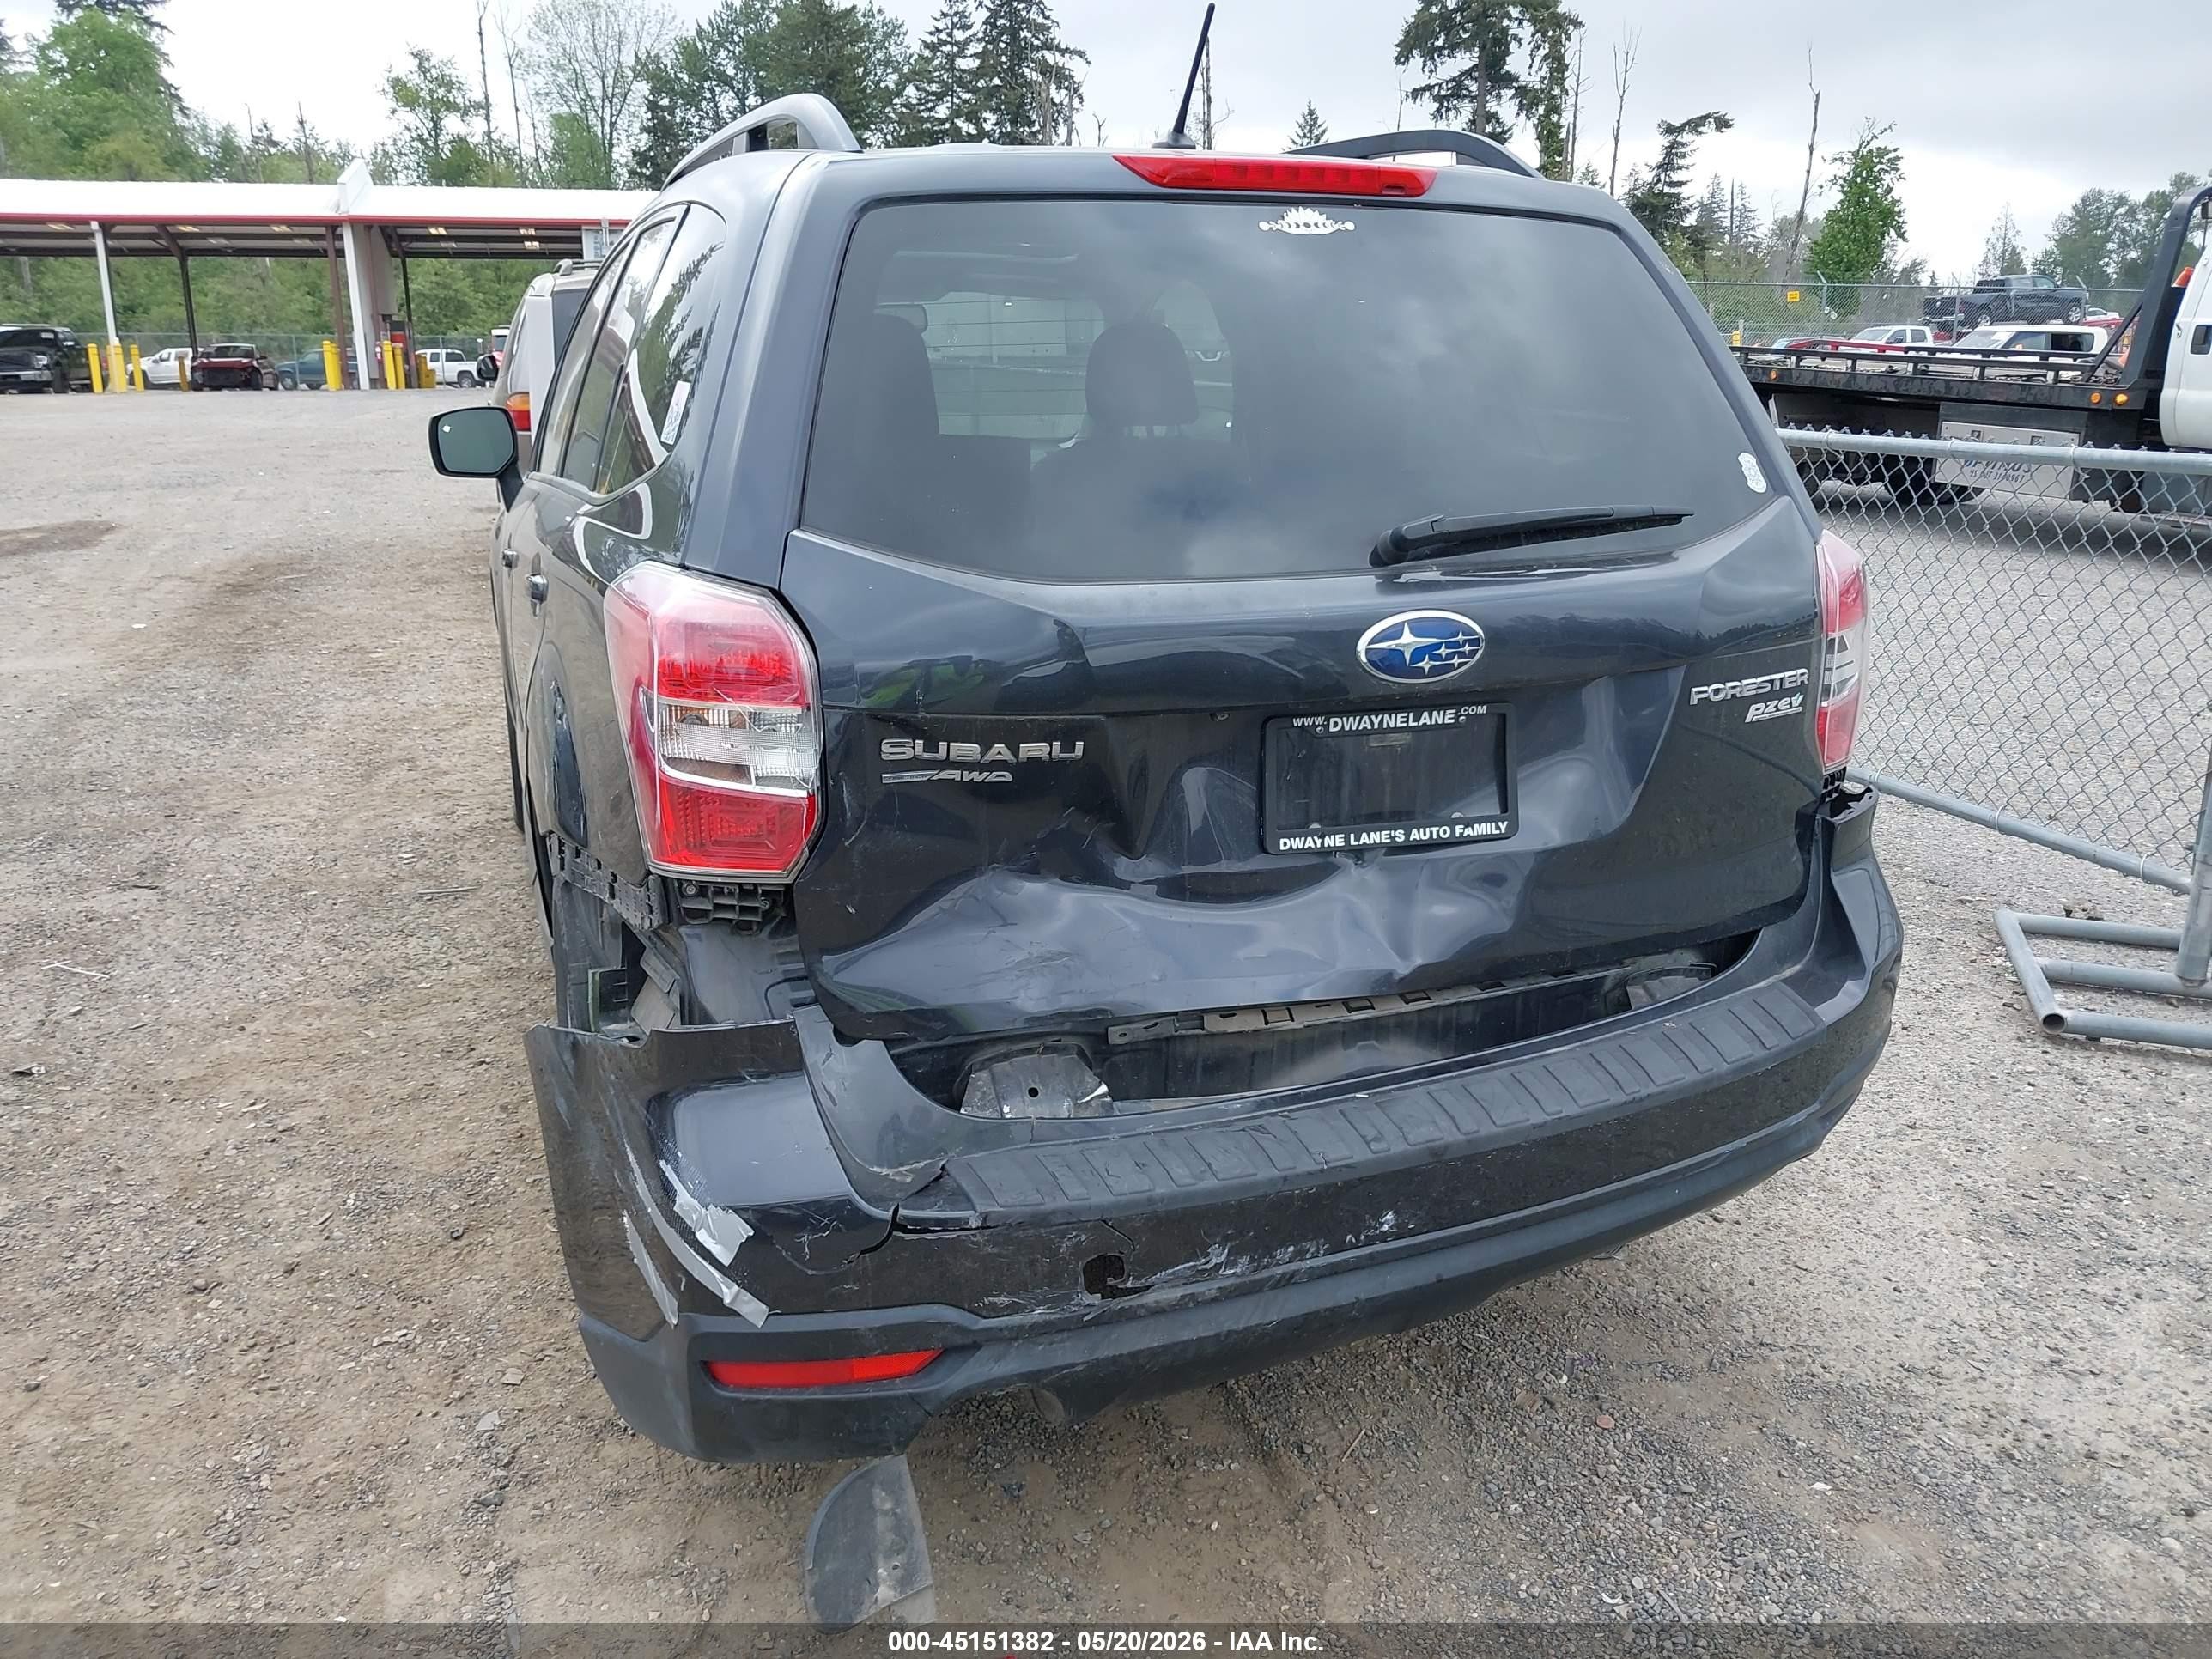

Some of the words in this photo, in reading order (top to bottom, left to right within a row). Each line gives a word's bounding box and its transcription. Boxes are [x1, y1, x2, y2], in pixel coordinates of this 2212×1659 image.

[1689, 667, 1809, 705] FORESTER
[880, 738, 1085, 763] SUBARU
[930, 769, 1013, 782] AWD
[1279, 834, 1346, 851] DWAYNE
[1349, 829, 1406, 846] LANE'S
[1409, 826, 1451, 841] AUTO
[1455, 821, 1509, 837] FAMILY
